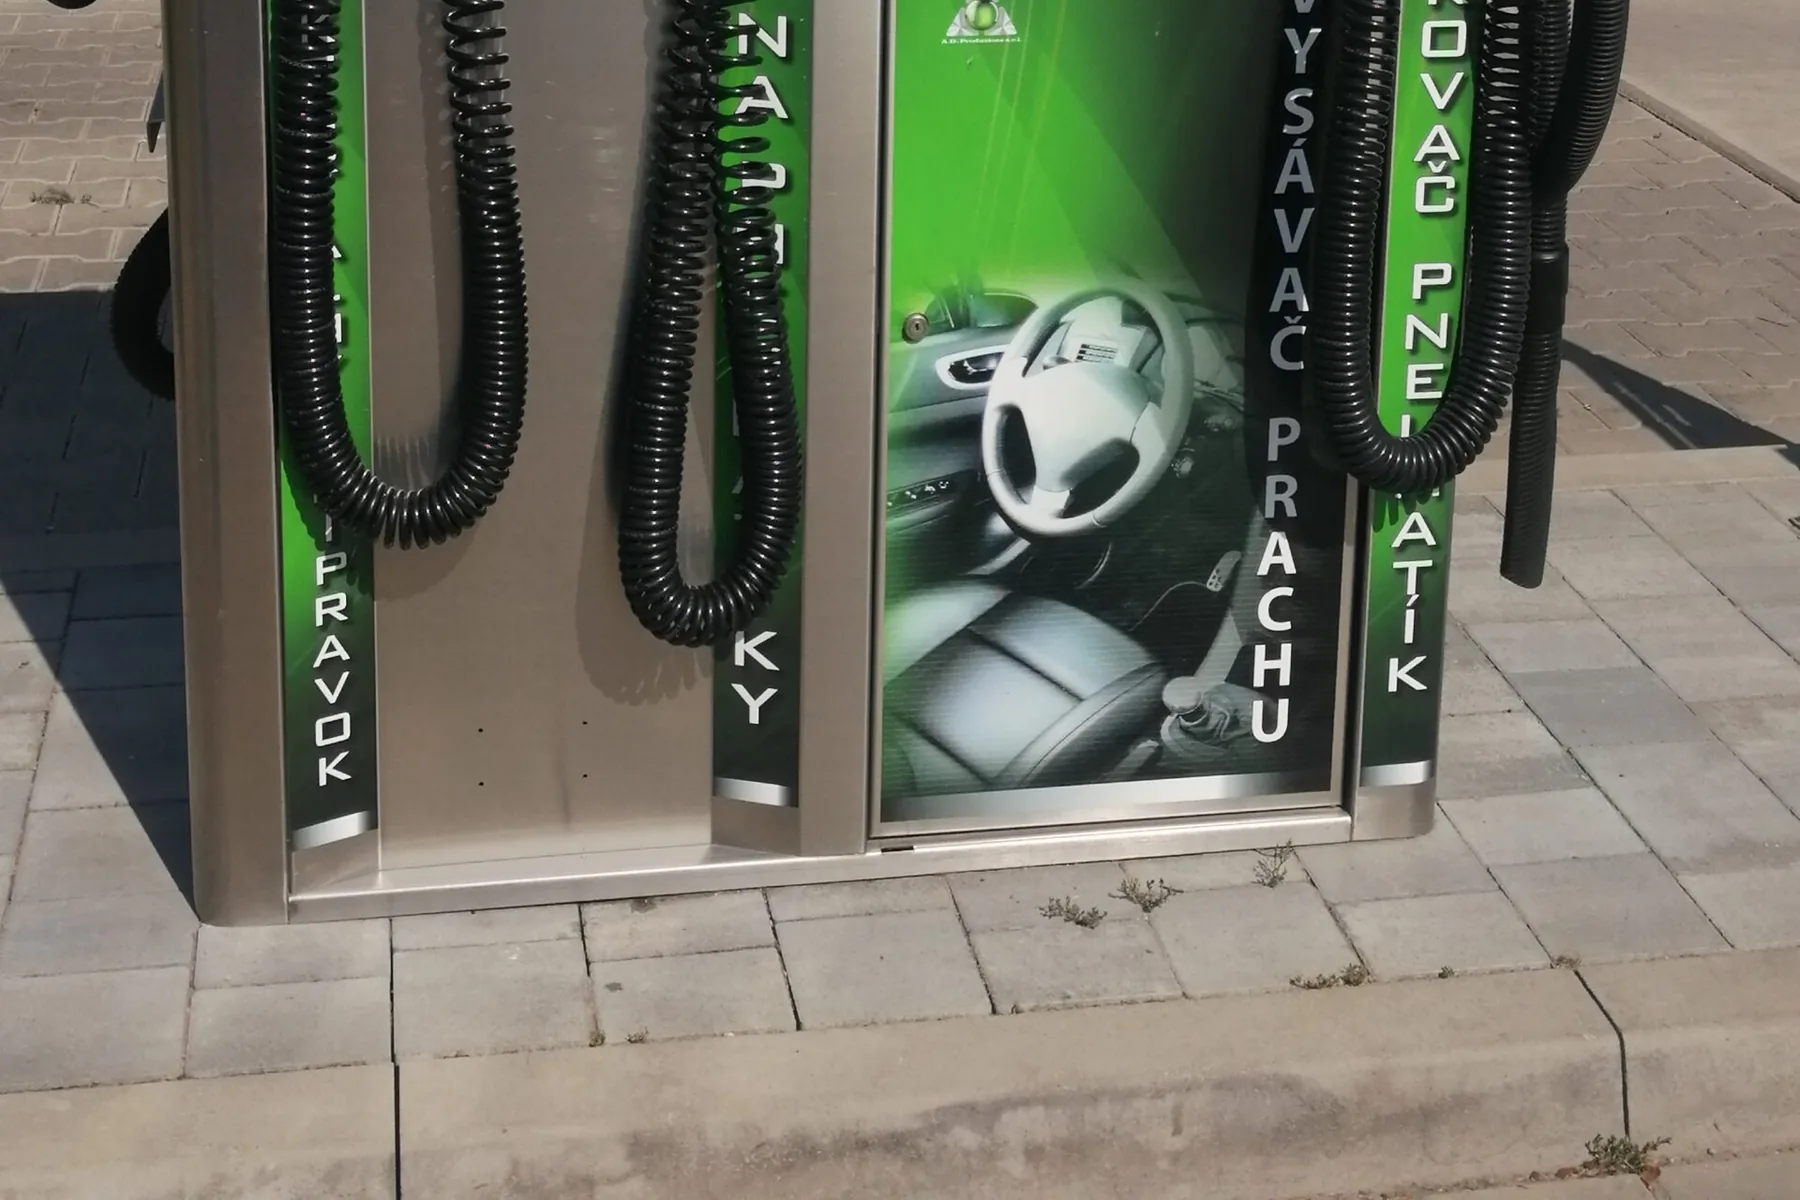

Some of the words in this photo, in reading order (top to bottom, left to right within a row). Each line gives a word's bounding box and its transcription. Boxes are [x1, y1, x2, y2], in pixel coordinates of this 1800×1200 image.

[734, 12, 788, 119] NA
[1251, 417, 1300, 743] PRACHU
[1387, 262, 1453, 693] PNEATÍK
[313, 490, 351, 786] PRAVOK
